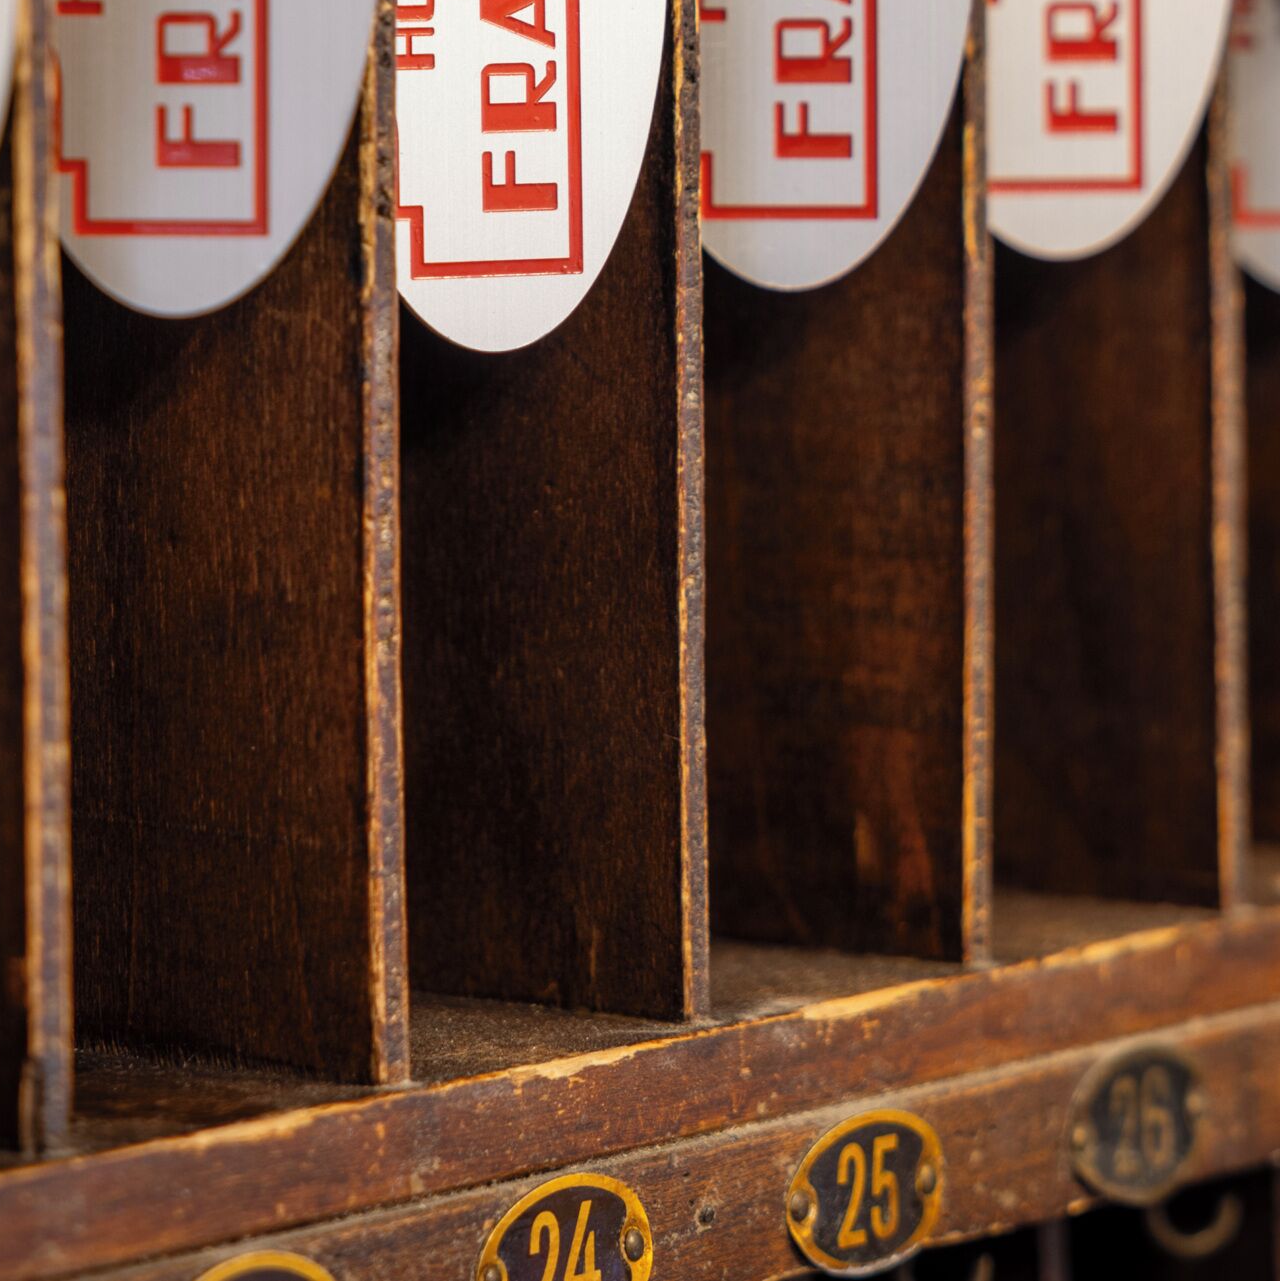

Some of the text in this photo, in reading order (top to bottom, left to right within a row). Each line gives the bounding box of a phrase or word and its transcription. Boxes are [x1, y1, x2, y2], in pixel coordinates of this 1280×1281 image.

[1110, 1064, 1177, 1181] 26
[529, 1199, 603, 1281] 24
[836, 1131, 902, 1251] 25
